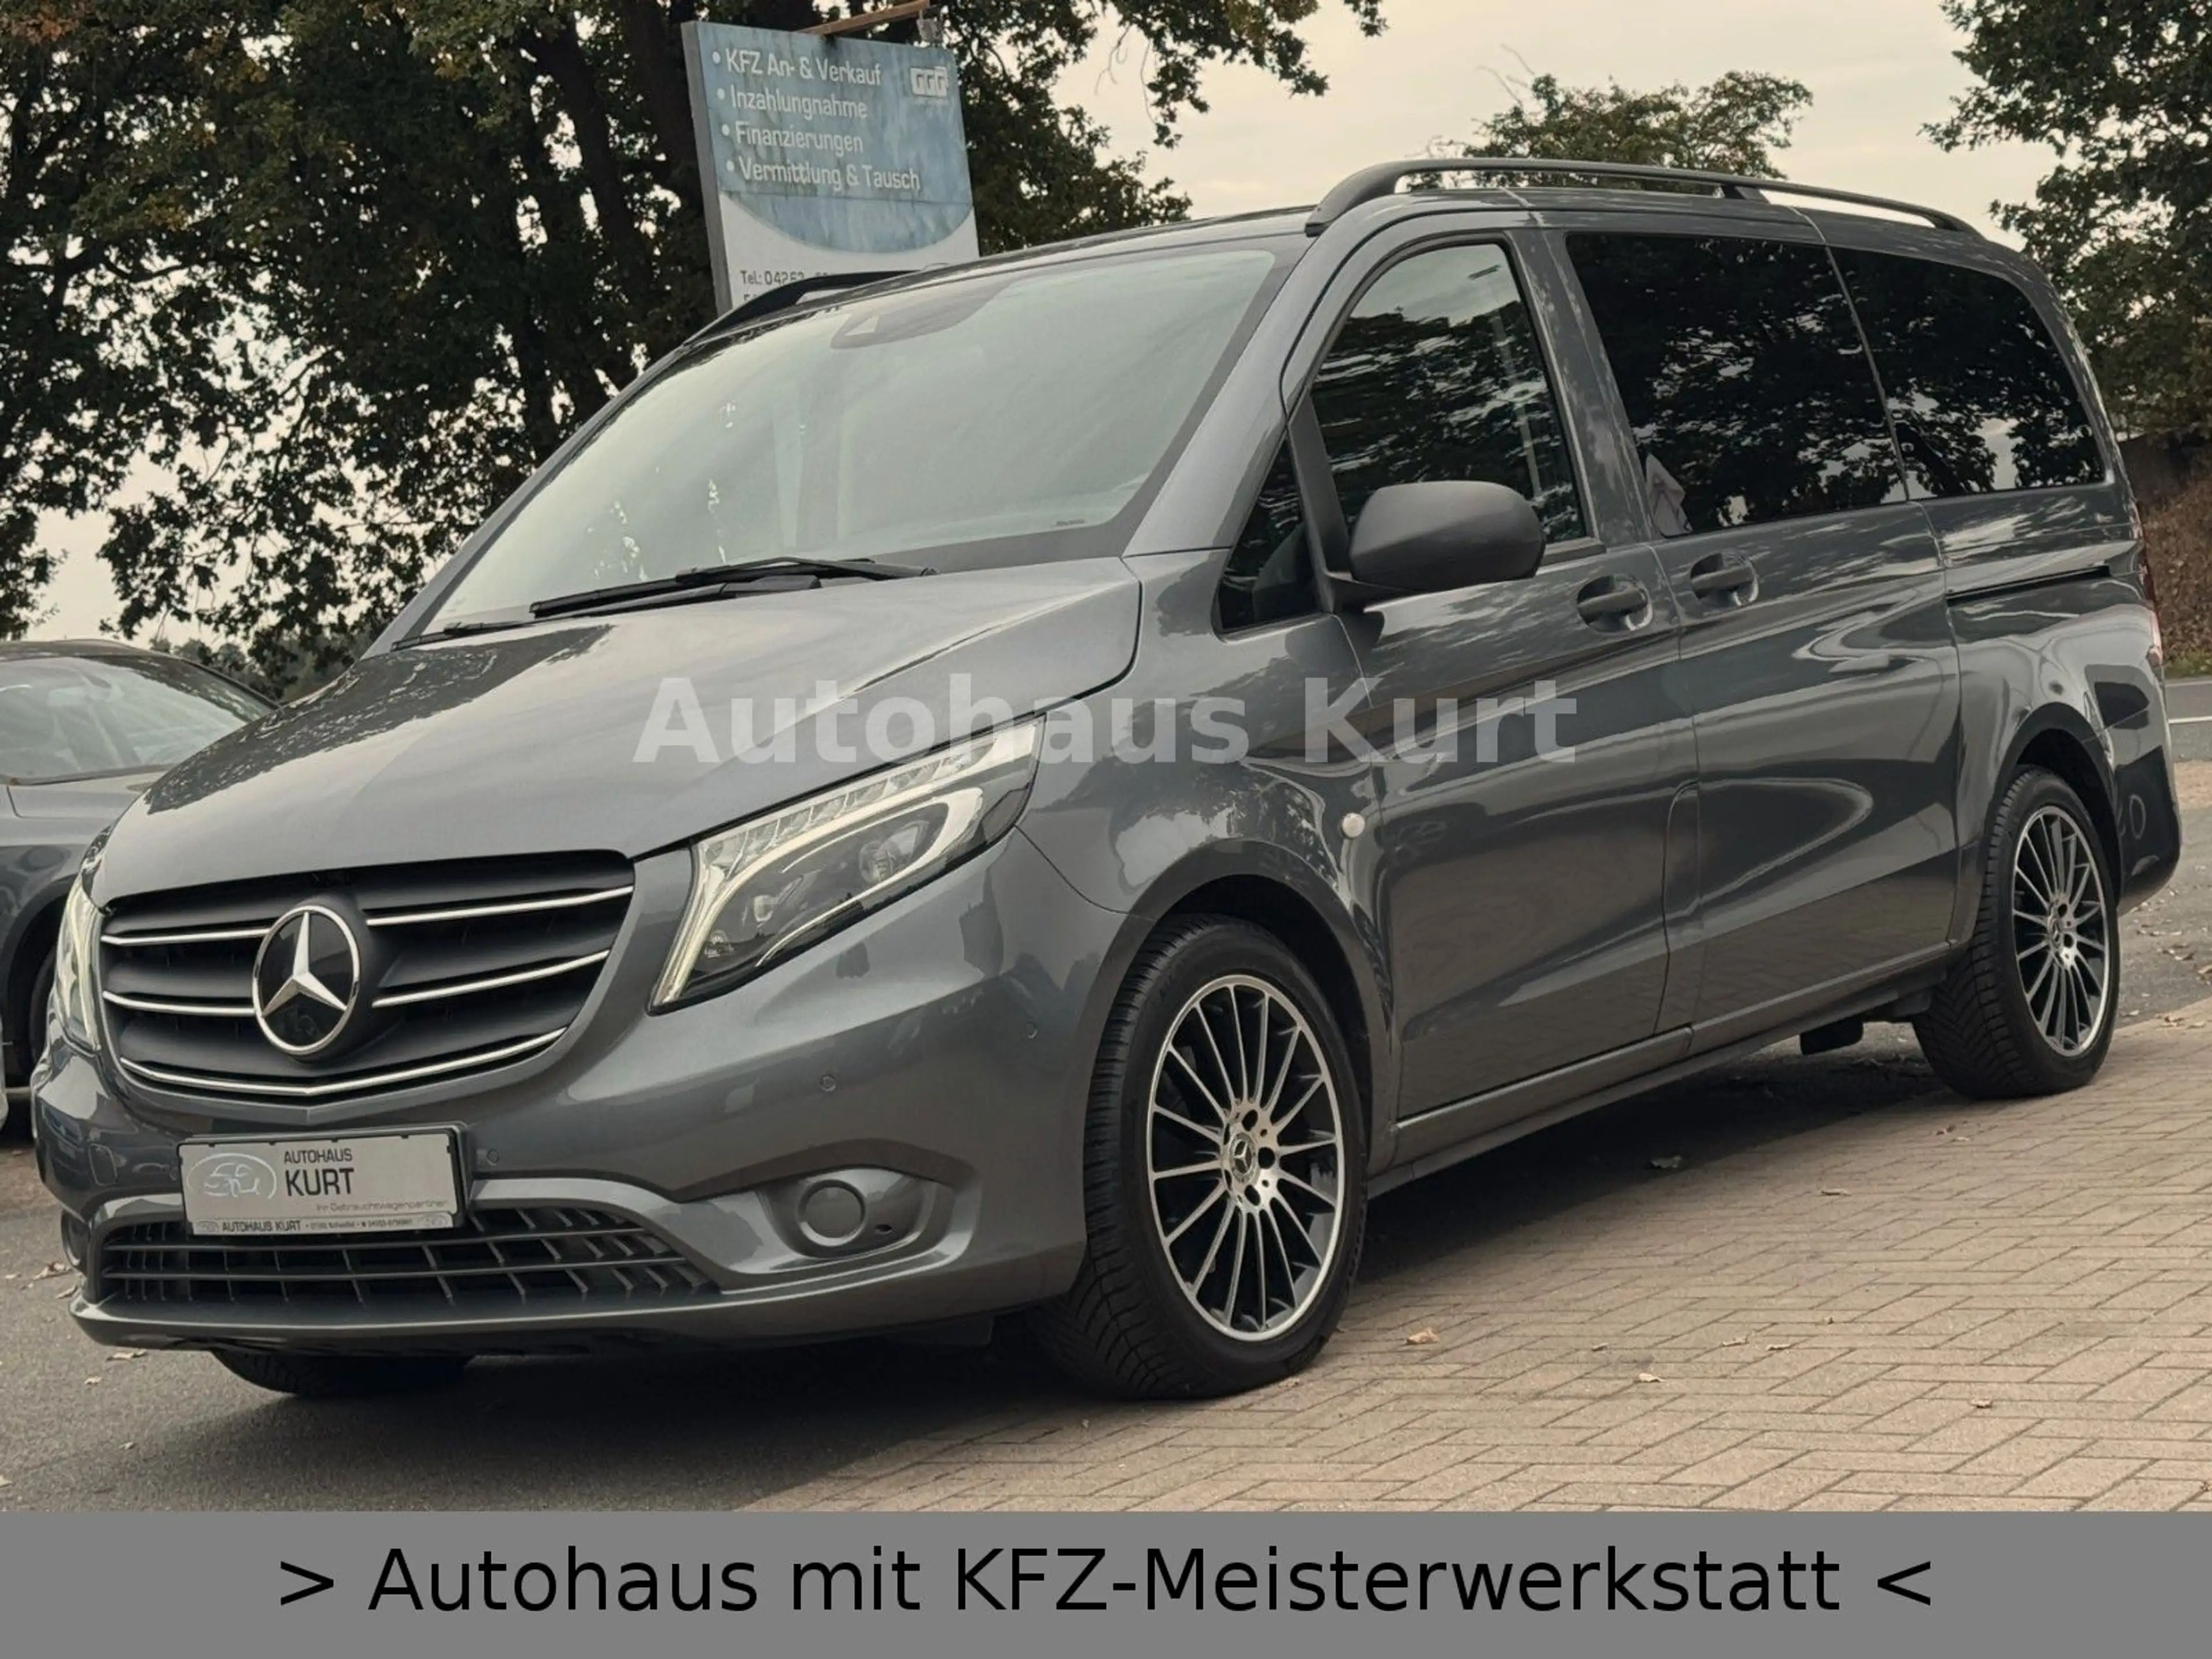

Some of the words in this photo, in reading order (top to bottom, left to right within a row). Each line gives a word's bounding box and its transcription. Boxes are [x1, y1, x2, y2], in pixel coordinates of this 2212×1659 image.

[725, 48, 764, 74] KFZ
[767, 52, 795, 77] An-
[798, 57, 813, 79] &
[815, 57, 882, 86] Verkauf
[730, 84, 868, 120] Inzahlungnahme
[735, 120, 863, 157] Finanzierungen
[738, 156, 842, 191] Vermittlung
[846, 163, 859, 186] &
[862, 165, 921, 191] Tausch
[284, 1148, 353, 1164] AUTOHAUS
[285, 1168, 355, 1197] KURT
[222, 1221, 272, 1232] AUTOHAUS
[275, 1219, 301, 1231] KURT
